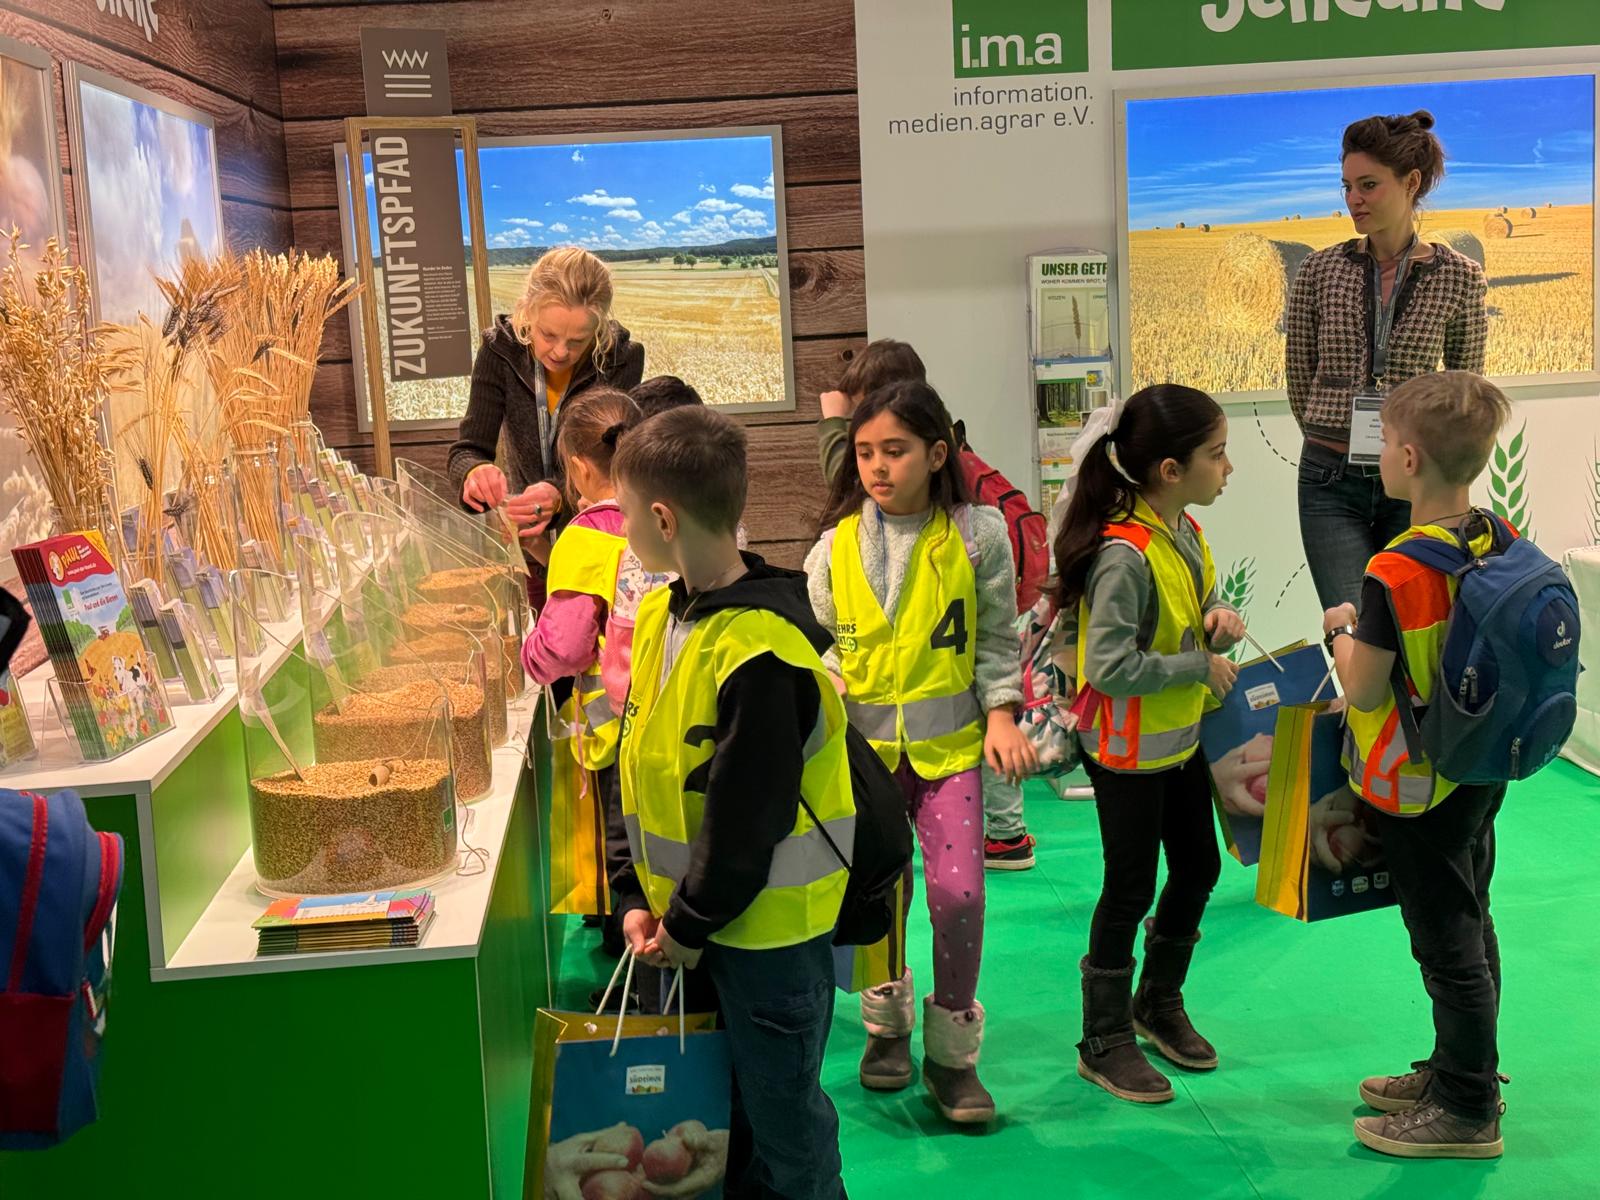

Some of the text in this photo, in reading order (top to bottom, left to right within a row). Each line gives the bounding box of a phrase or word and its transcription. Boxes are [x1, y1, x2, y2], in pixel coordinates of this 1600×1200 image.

[962, 24, 1062, 68] i.m.a
[954, 82, 1094, 106] information.
[889, 106, 1094, 134] medien.agrar e.V.
[375, 136, 427, 376] ZUKUNFTSPFAD
[1042, 263, 1078, 276] UNSER
[61, 546, 80, 568] PAUL
[930, 598, 968, 655] 4
